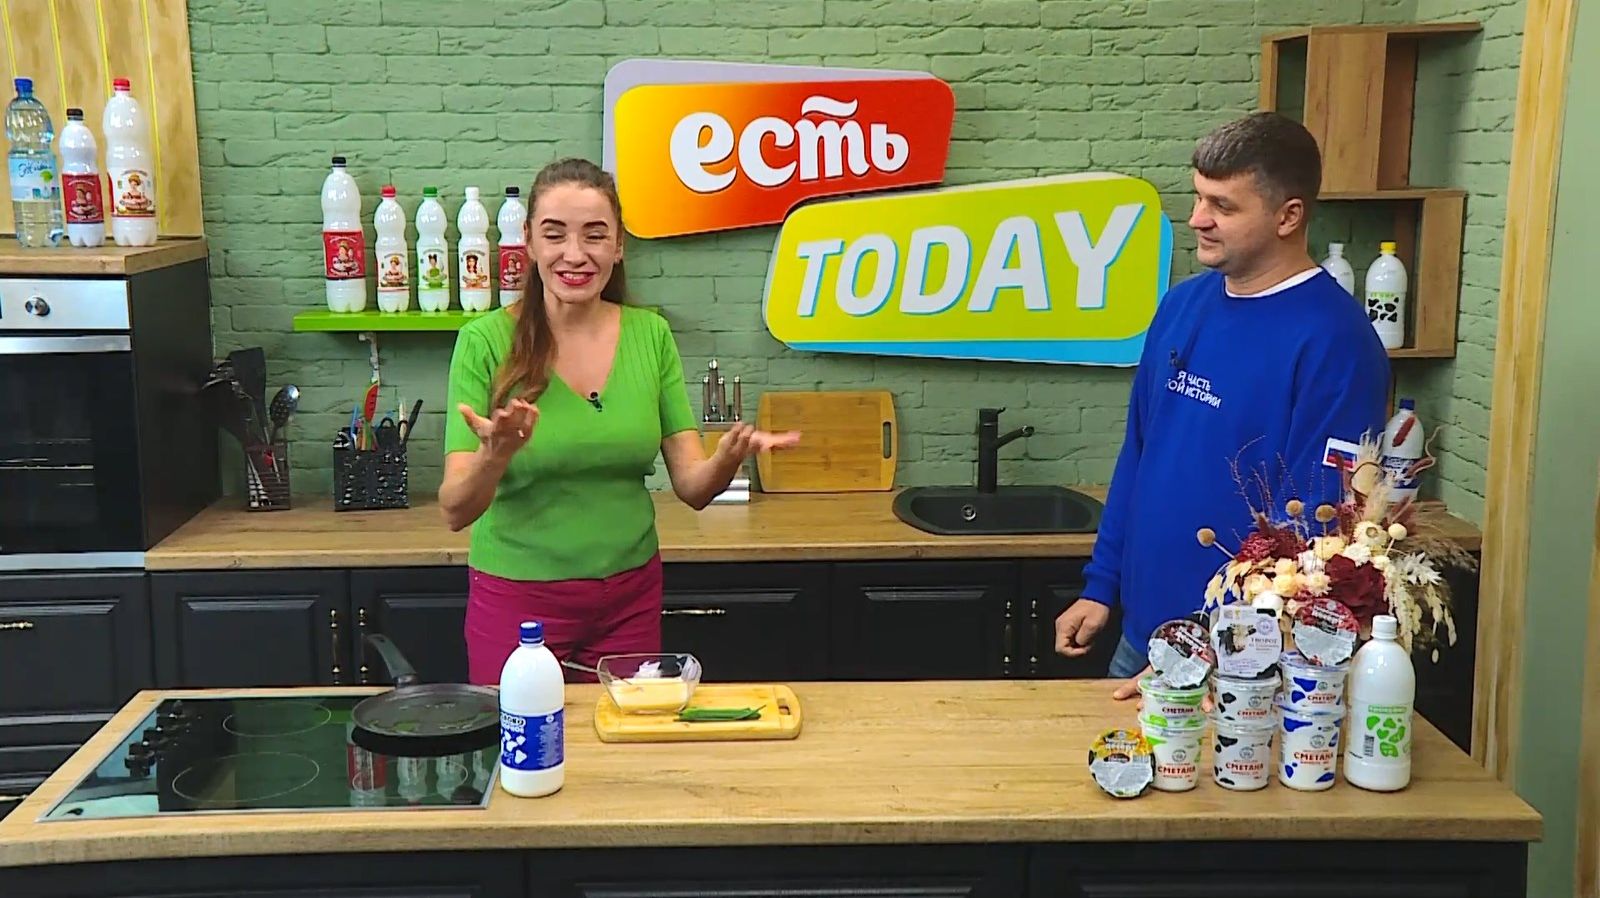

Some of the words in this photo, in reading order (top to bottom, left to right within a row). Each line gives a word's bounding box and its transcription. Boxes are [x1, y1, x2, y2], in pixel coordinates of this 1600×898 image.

[669, 95, 910, 193] есть
[796, 203, 1146, 319] TODAY
[1177, 370, 1187, 380] Я
[1187, 373, 1211, 391] ЧАСТЬ
[1164, 378, 1186, 394] ОЙ
[1184, 385, 1222, 409] ИСТОРИИ
[1293, 751, 1334, 760] СМЕТАНА
[1157, 765, 1196, 774] СМЕТАНА
[1225, 762, 1264, 771] СМЕТАНА
